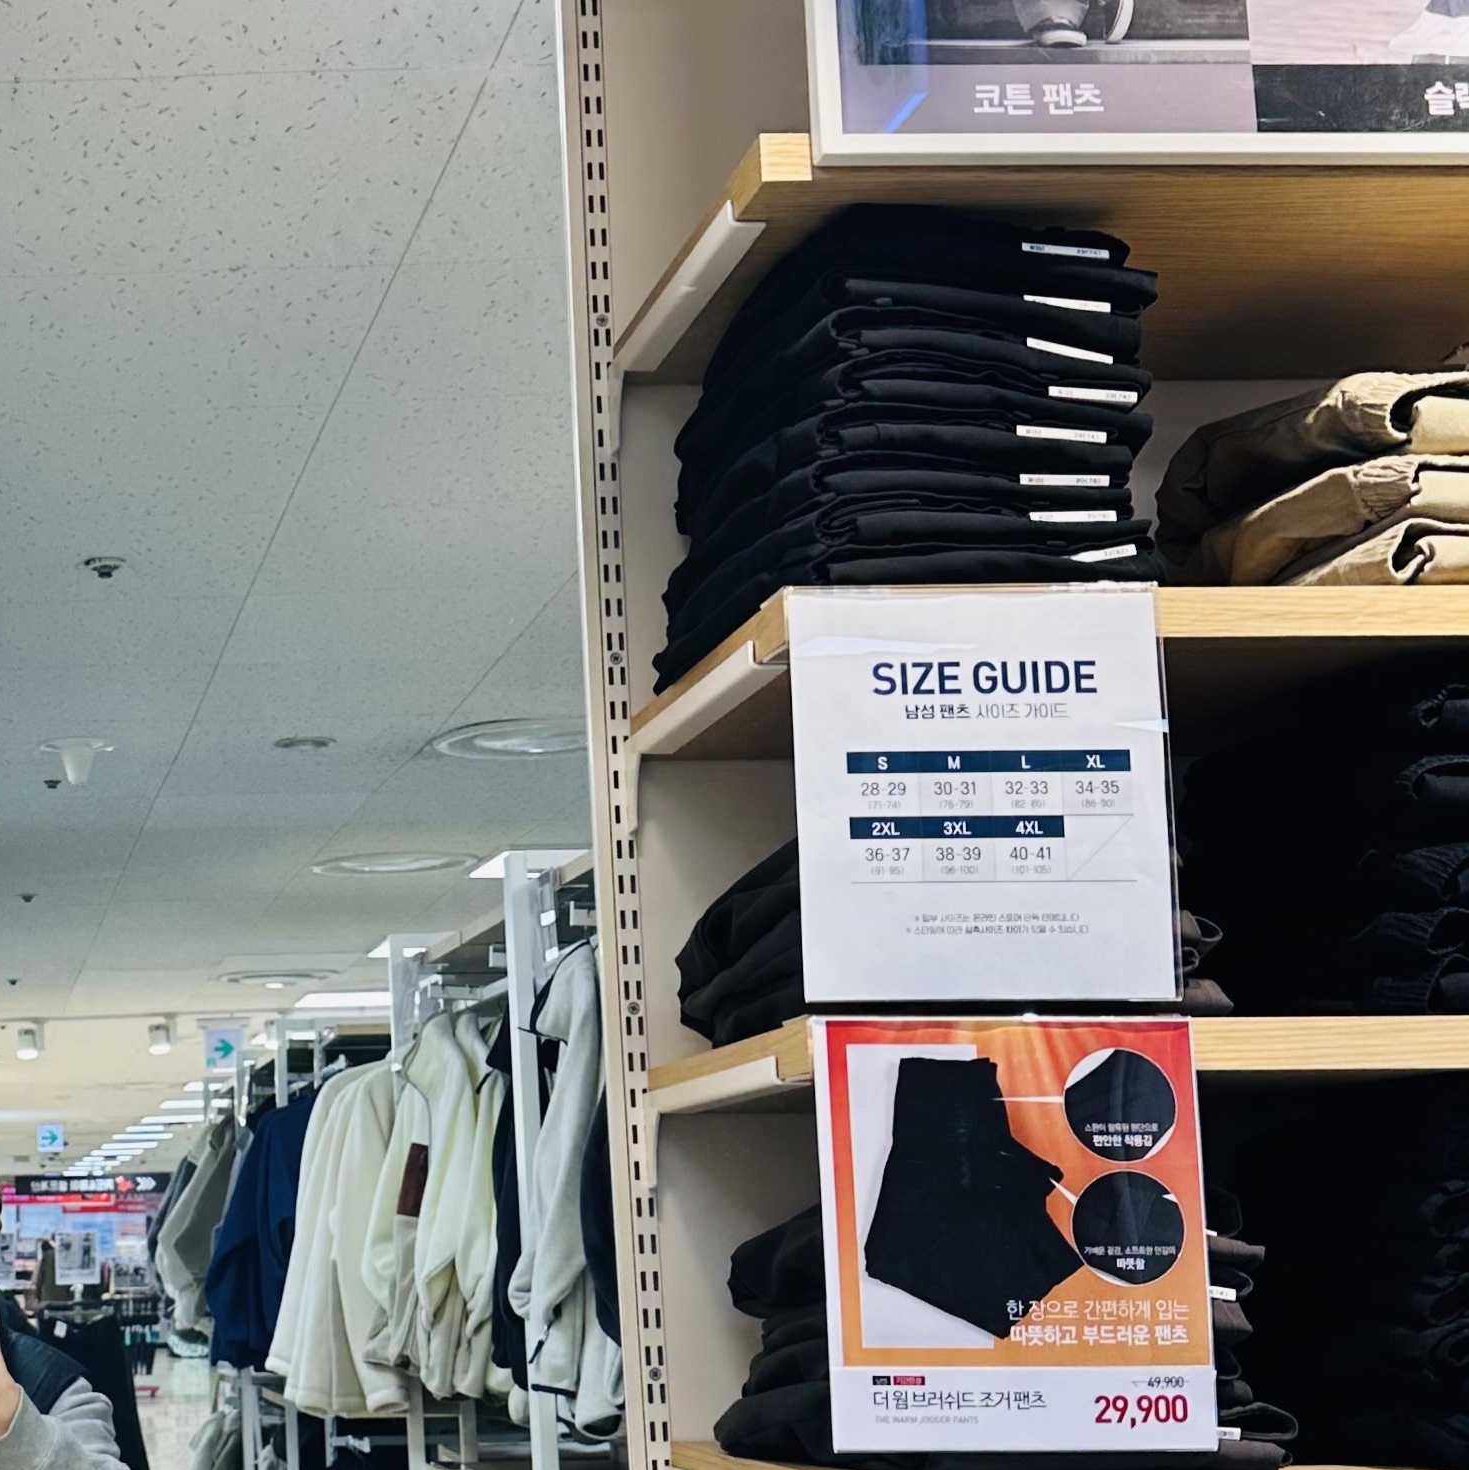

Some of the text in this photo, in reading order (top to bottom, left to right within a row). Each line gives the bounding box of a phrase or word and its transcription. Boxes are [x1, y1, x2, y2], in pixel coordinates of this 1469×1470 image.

[973, 83, 1105, 116] 코튼 팬츠
[872, 660, 1098, 695] SIZE GUIDE
[905, 702, 1069, 720] 남성 팬츠 사이즈 가이드
[877, 754, 1106, 770] S M L XL
[860, 780, 1120, 796] 28-29 30-31 32-33 34-35
[871, 820, 1044, 836] 2XL 3XL 4XL
[865, 846, 1052, 861] 36-37 38-39 40-41
[1092, 1134, 1153, 1147] 편안한 착용감
[1116, 1257, 1145, 1270] 따뜻함
[1006, 1299, 1190, 1321] 한 장으로 간편하게 입는
[1010, 1325, 1189, 1346] 따뜻하고 부드러운 팬츠
[1147, 1376, 1185, 1389] 49,900
[873, 1390, 889, 1410] 더
[875, 1415, 979, 1424] THE WARM JOGGER PANTS
[1094, 1394, 1188, 1429] 29,900
